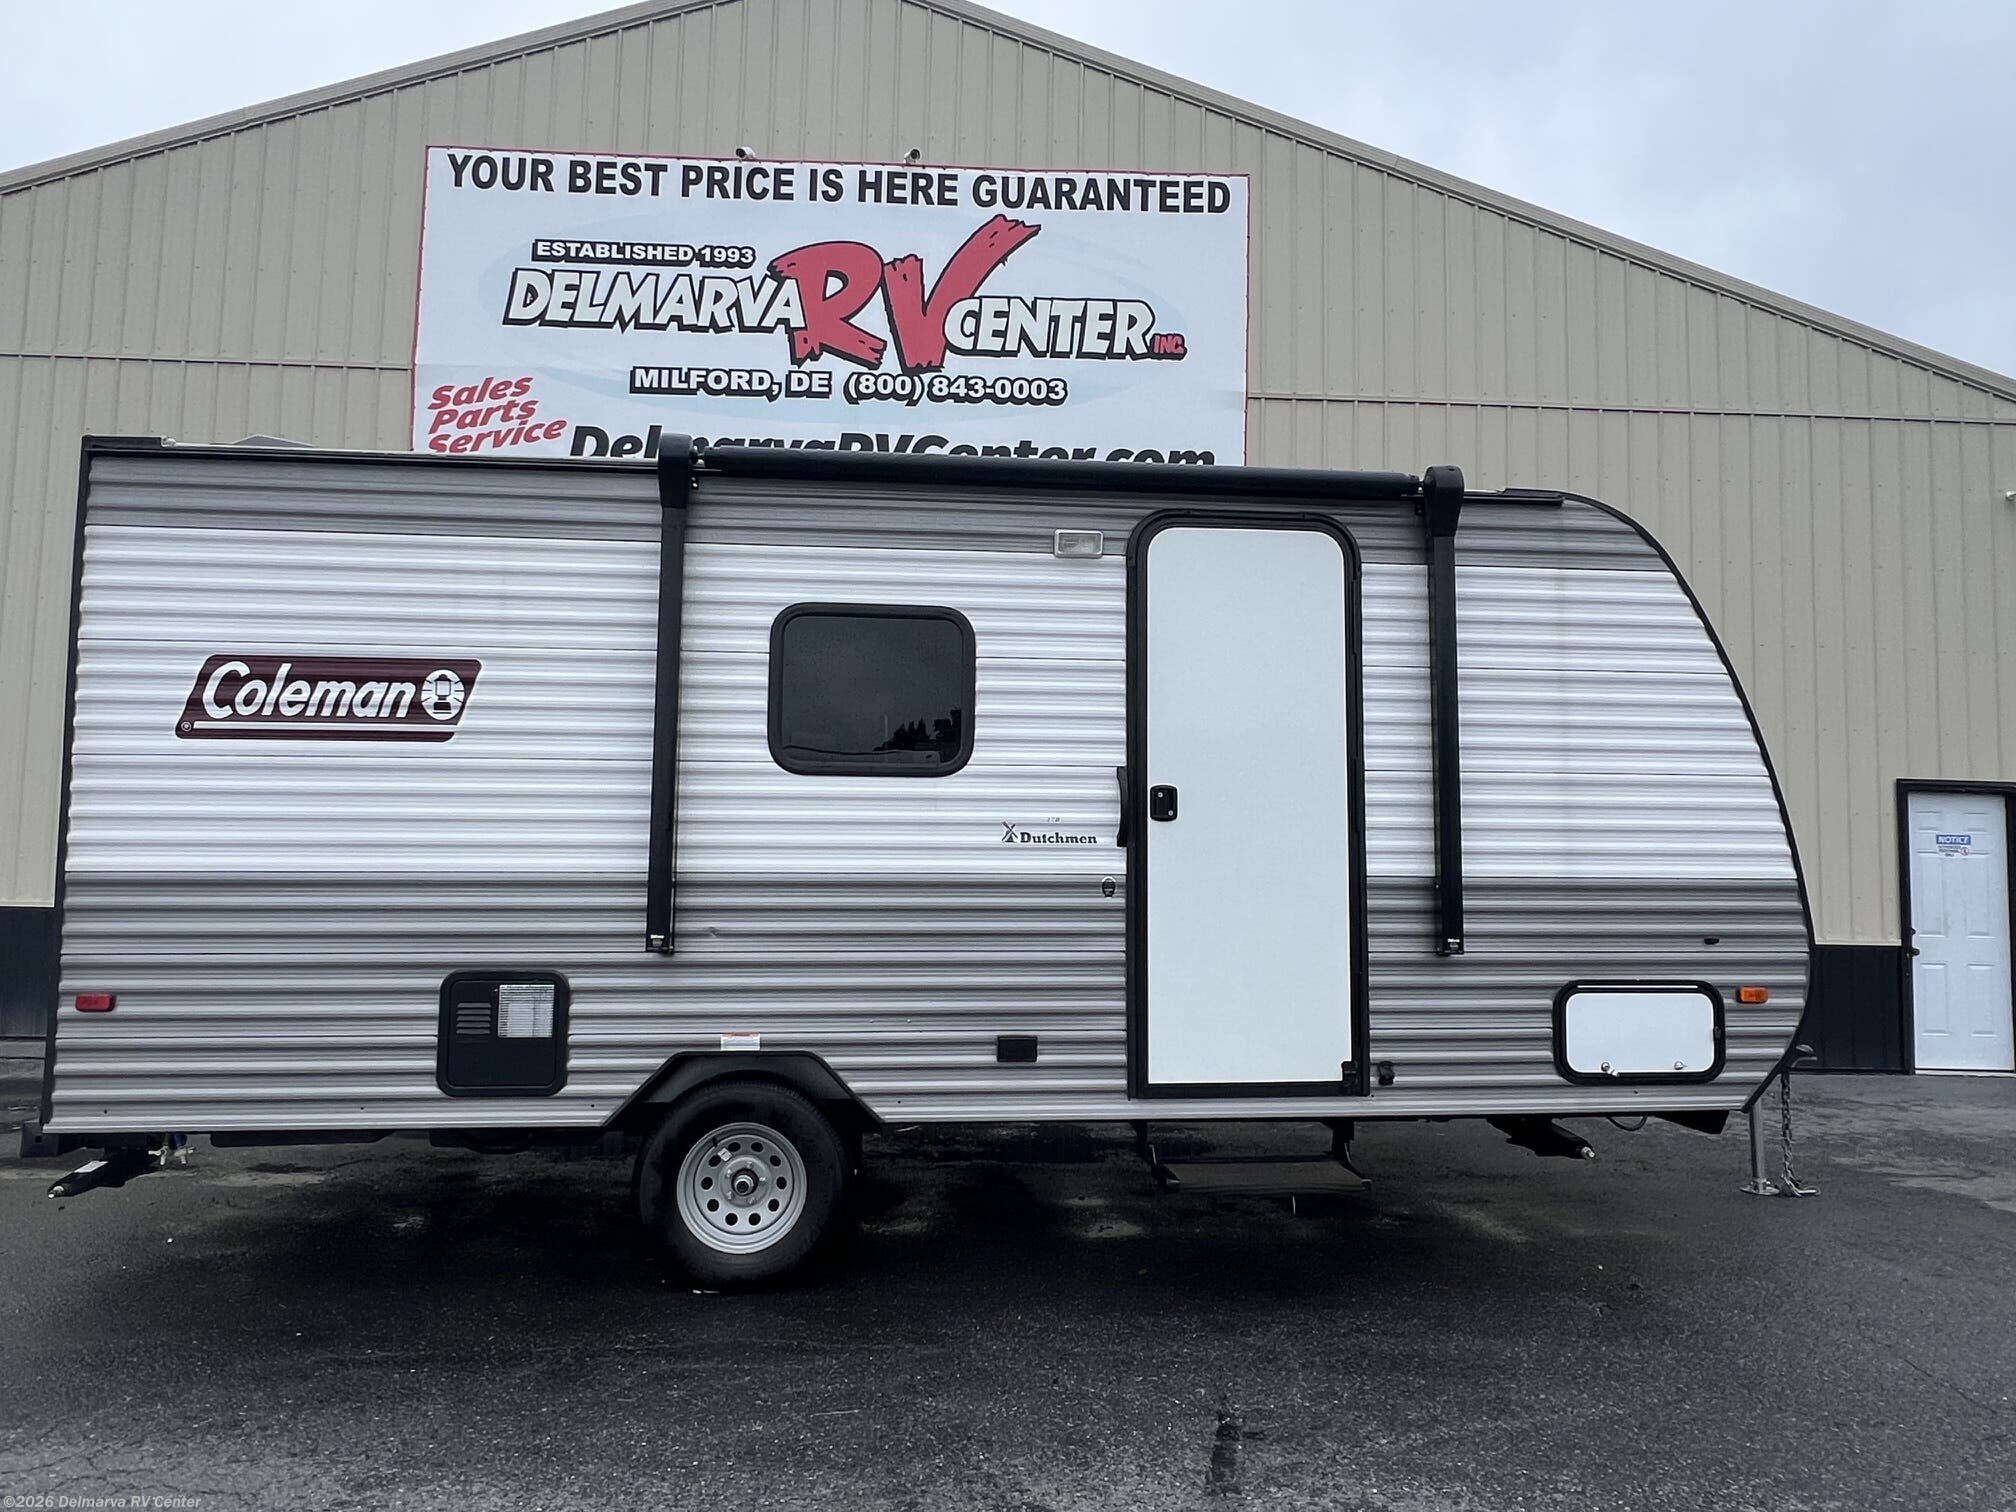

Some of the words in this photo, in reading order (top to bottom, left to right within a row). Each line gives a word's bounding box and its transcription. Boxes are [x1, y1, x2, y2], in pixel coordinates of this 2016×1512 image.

[447, 153, 555, 193] YOUR
[568, 159, 668, 197] BEST
[681, 164, 796, 201] PRICE
[809, 168, 844, 202] IS
[857, 169, 959, 207] HERE
[971, 174, 1232, 214] GUARANTEED
[535, 240, 694, 264] ESTABLISHED
[700, 245, 755, 265] 1993
[503, 267, 807, 333] DELMARVA
[766, 213, 1042, 375] RV
[944, 296, 1155, 361] CENTER
[427, 376, 534, 410] Sales
[632, 367, 782, 398] MILFORD,
[787, 371, 832, 395] DE
[847, 372, 923, 403] (800)
[928, 375, 1068, 403] 843-0003
[428, 399, 539, 435] Parts
[428, 419, 568, 454] Service
[570, 425, 1215, 465] DelRVCtercom
[202, 660, 417, 720] Coleman
[1020, 831, 1098, 844] Dutchmen
